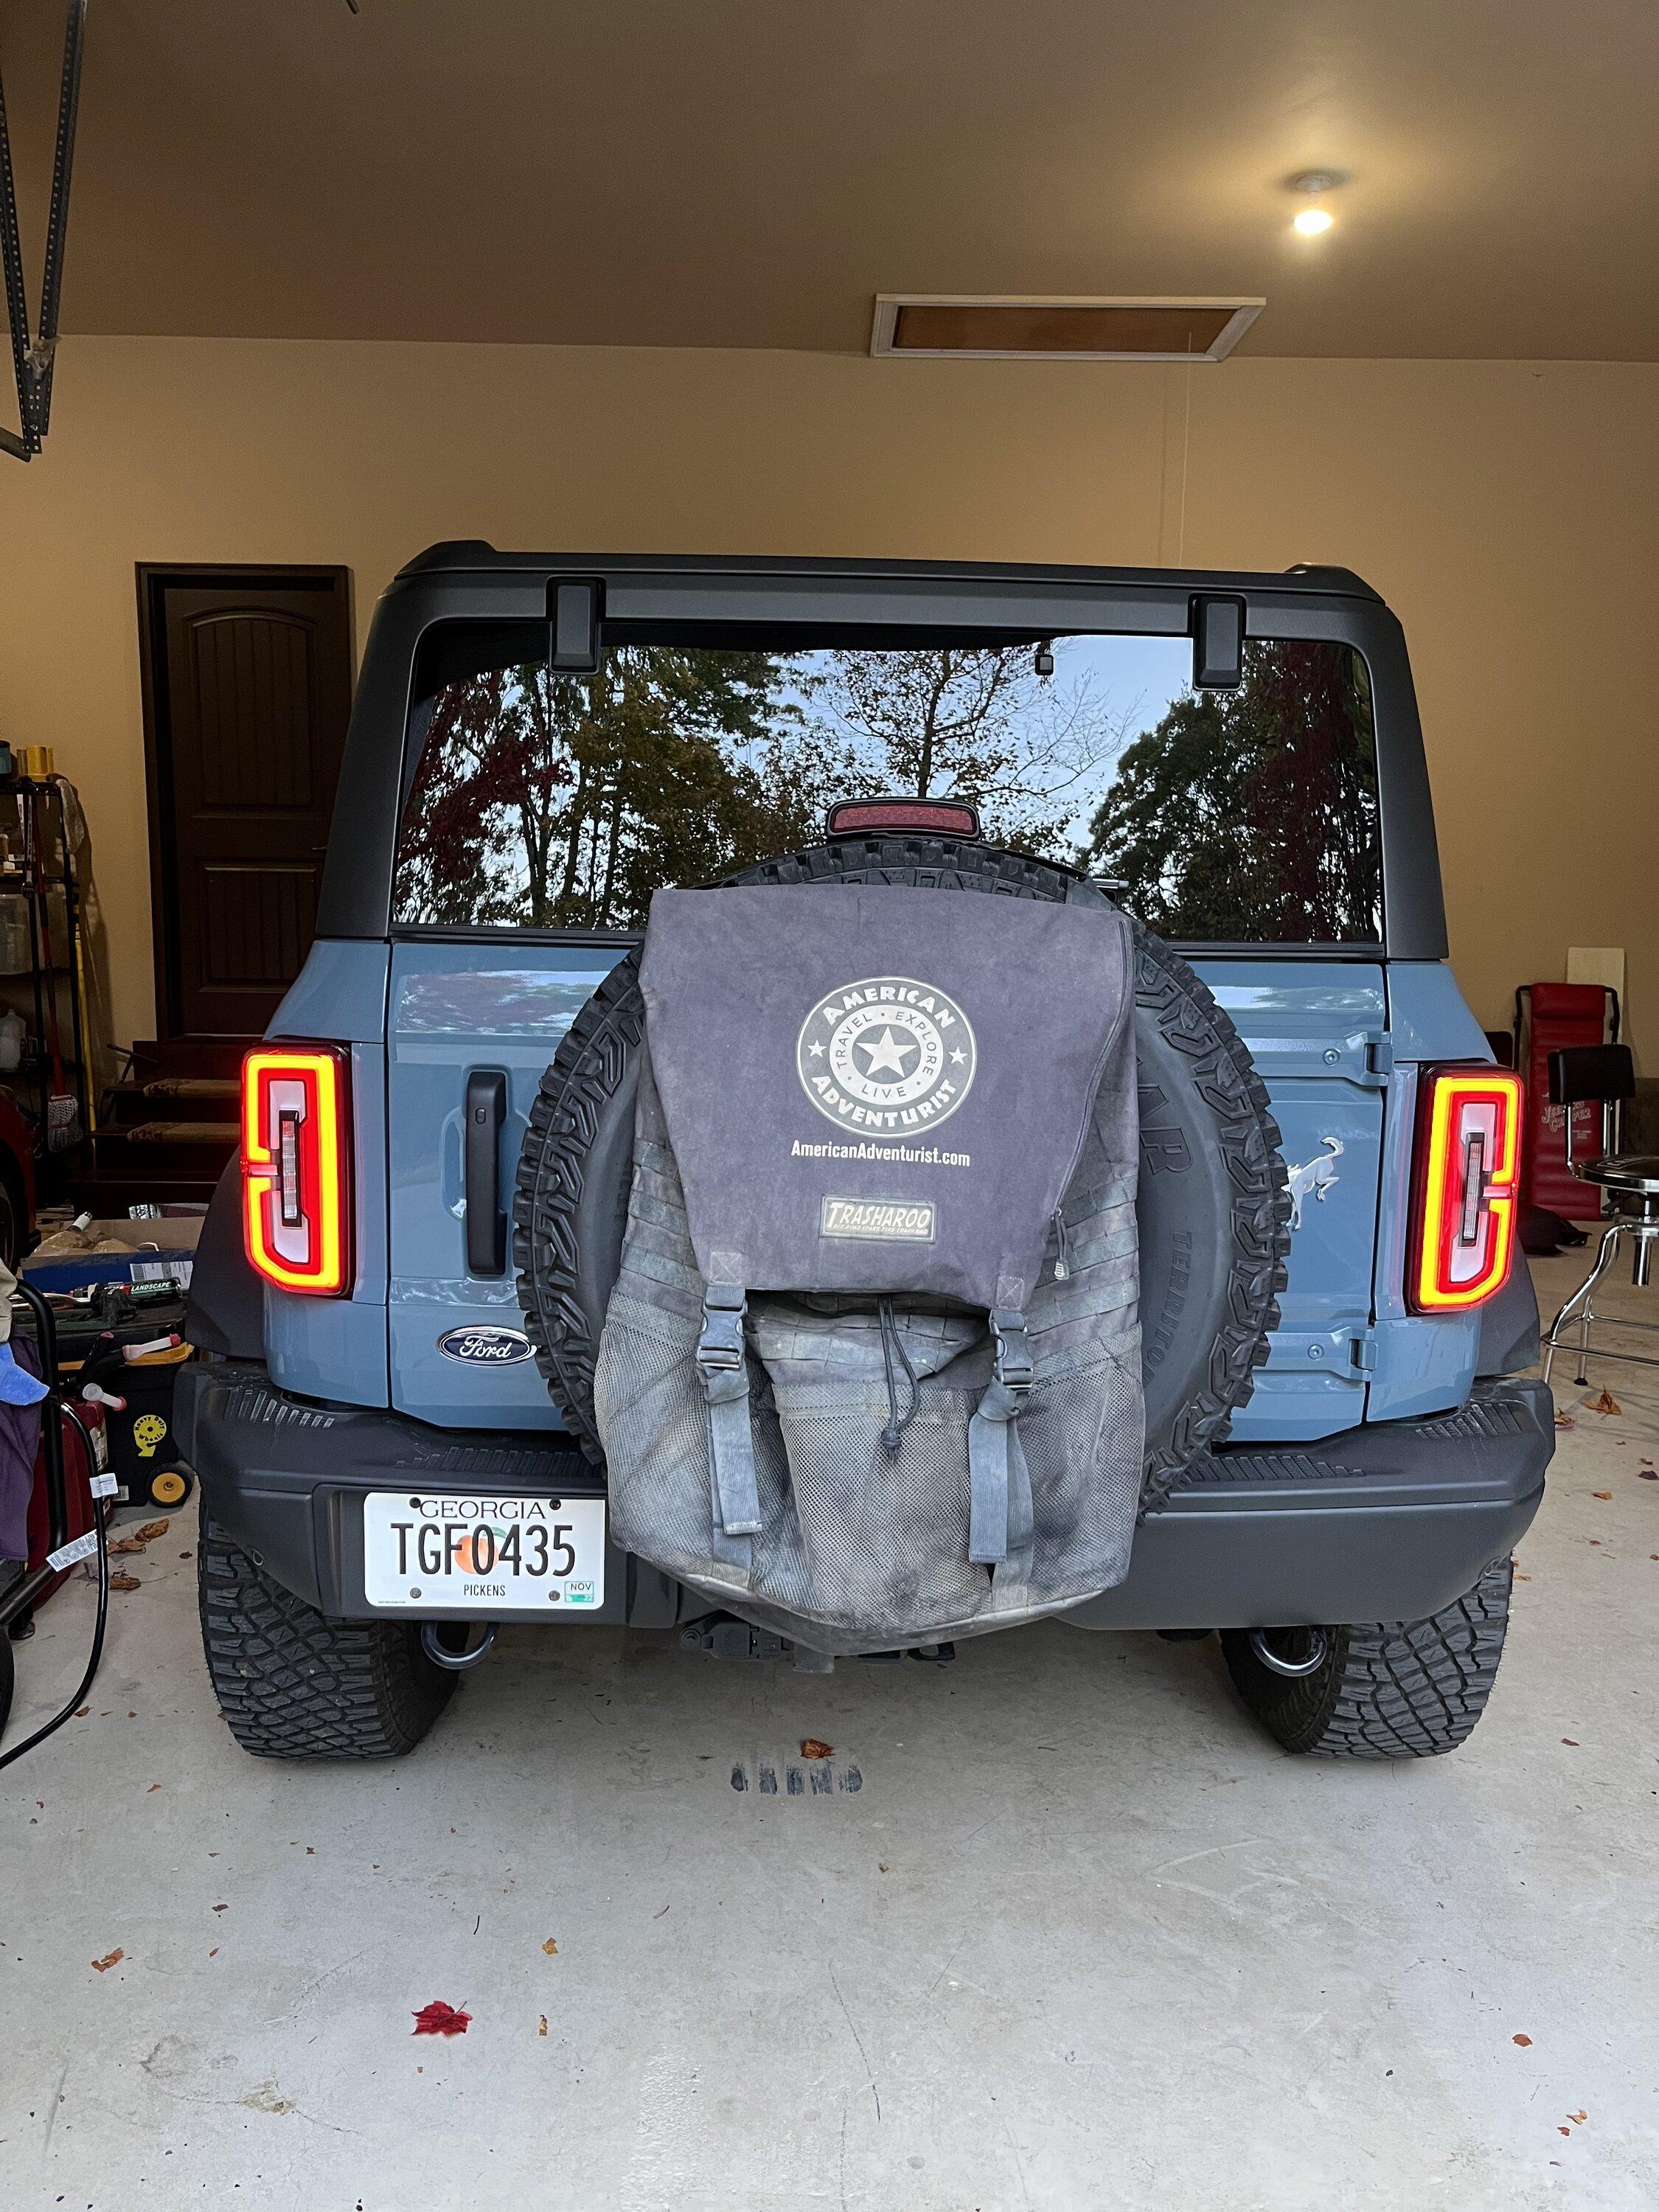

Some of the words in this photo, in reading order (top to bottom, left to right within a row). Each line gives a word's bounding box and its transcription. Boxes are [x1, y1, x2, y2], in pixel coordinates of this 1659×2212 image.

[823, 986, 956, 1029] AMERICAN
[836, 1013, 872, 1069] TRAVEL
[895, 1011, 937, 1077] EXPLORE
[811, 1075, 957, 1127] ADVENTURIST
[861, 1083, 907, 1099] LIVE
[790, 1139, 971, 1167] AmericanAdventurist.com
[827, 1202, 931, 1228] TRASHAROO
[131, 1281, 171, 1292] LANDSCAPE
[459, 1335, 512, 1357] Ford
[134, 1416, 152, 1431] Heavy
[154, 1416, 165, 1430] Duty
[139, 1433, 164, 1441] Wheels
[420, 1500, 547, 1520] GEORGIA
[390, 1522, 576, 1577] TGF0435
[463, 1584, 507, 1597] PICKENS
[571, 1582, 592, 1590] NOV
